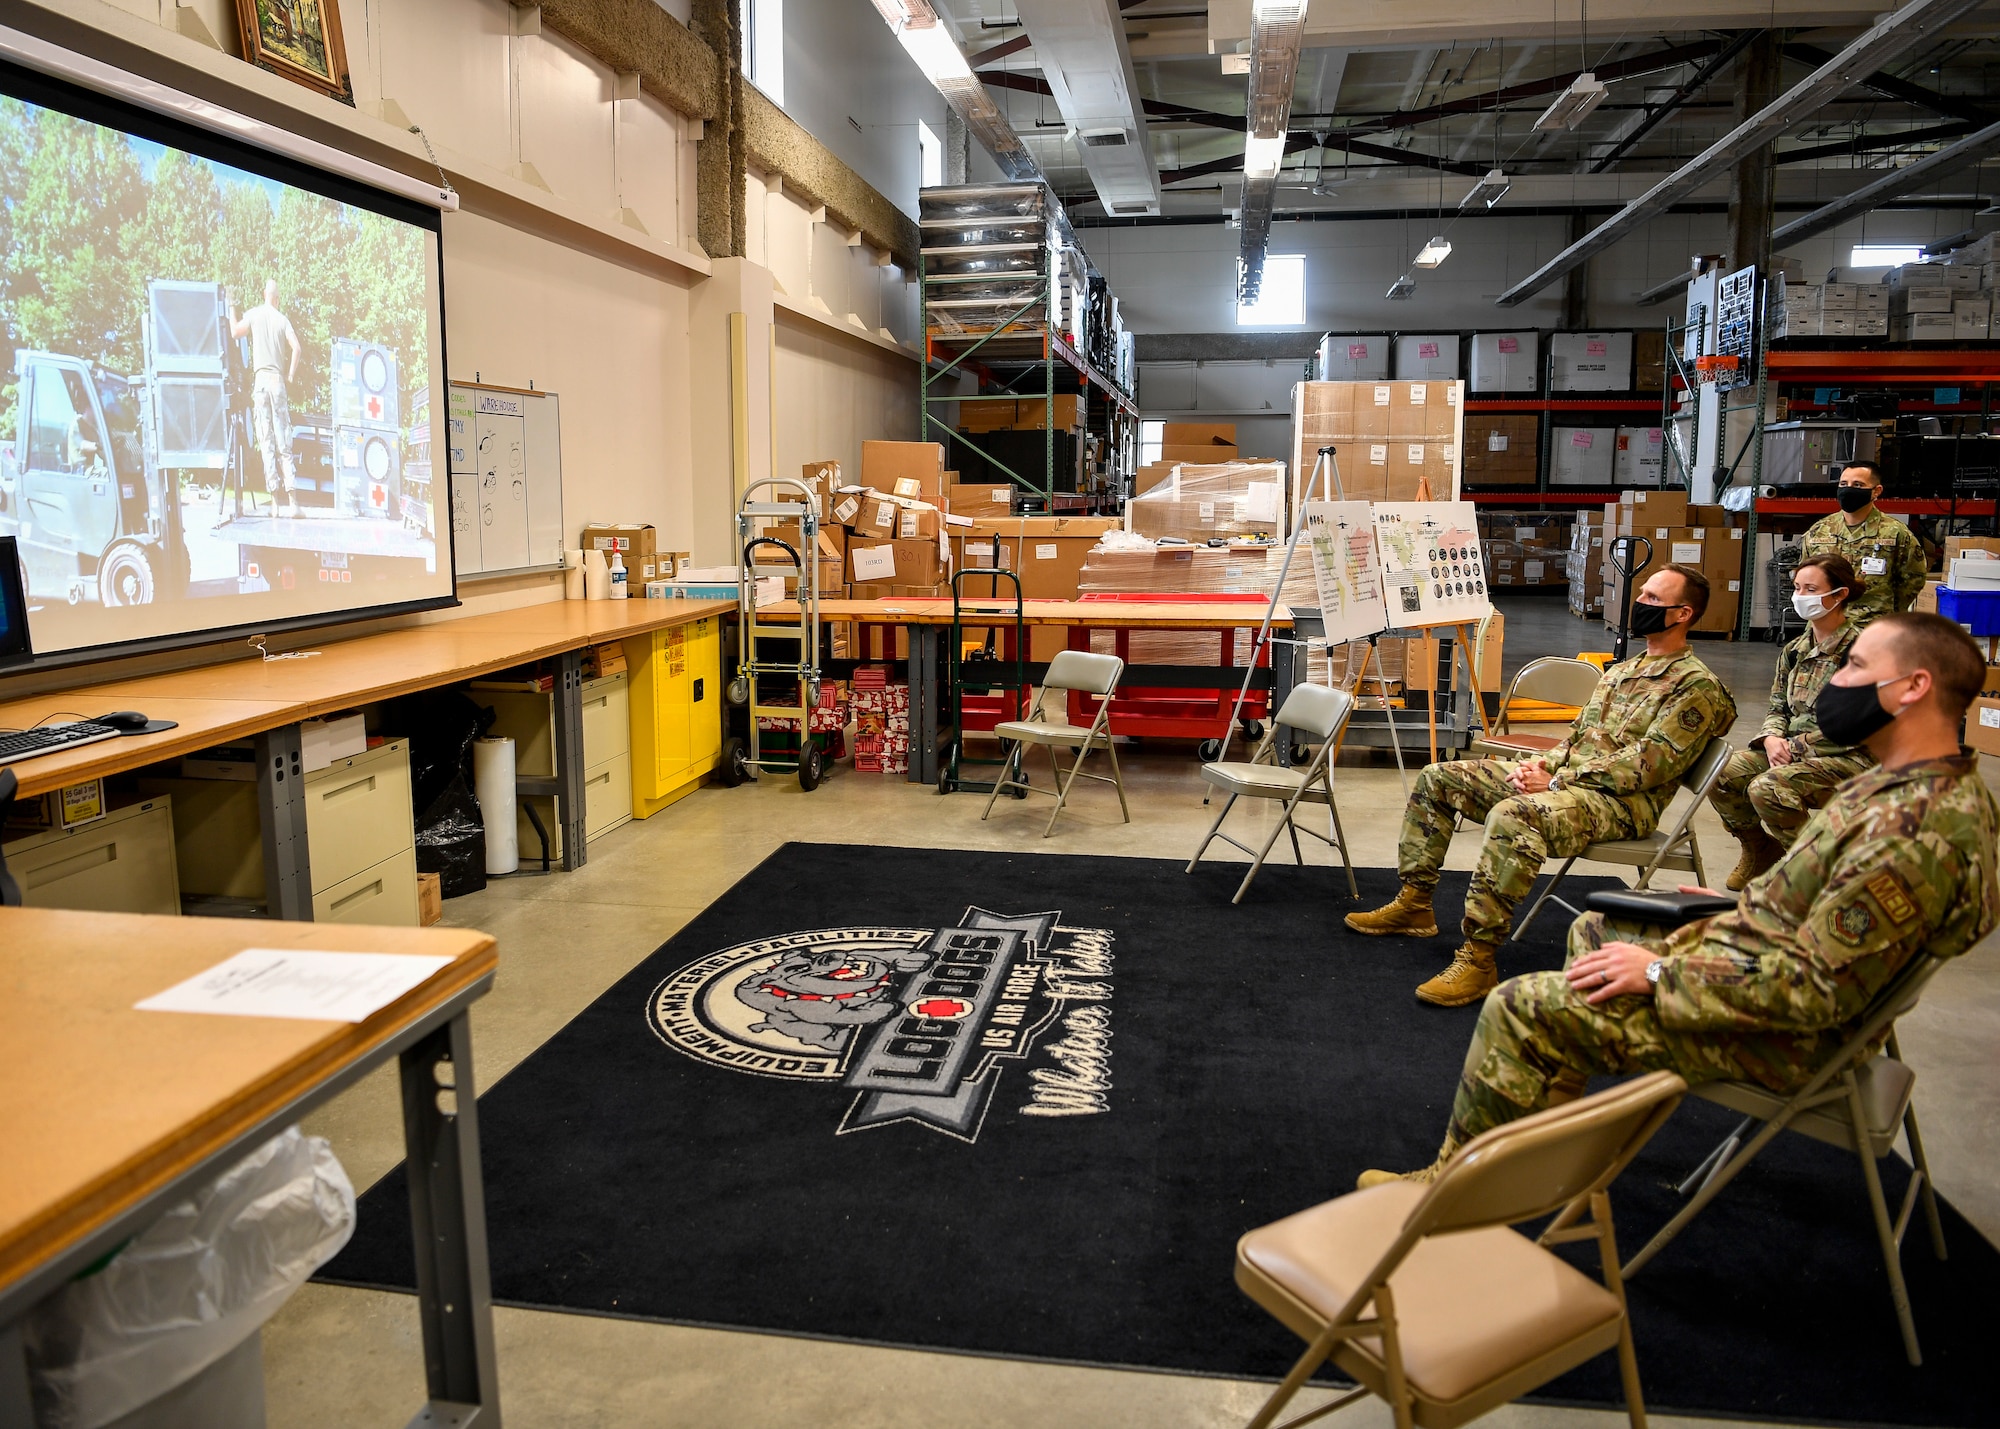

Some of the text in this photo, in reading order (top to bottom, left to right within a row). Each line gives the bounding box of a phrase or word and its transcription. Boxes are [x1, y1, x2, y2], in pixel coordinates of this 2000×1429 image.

[480, 396, 517, 412] WAREHOUSE
[74, 788, 82, 797] Gal
[1869, 875, 1912, 920] MED
[750, 931, 918, 952] FACILITIES
[662, 955, 744, 1012] MATERIEL
[1042, 981, 1114, 1000] It
[980, 963, 1042, 1048] US AIR FORCE
[665, 1018, 829, 1072] EQUIPMENT
